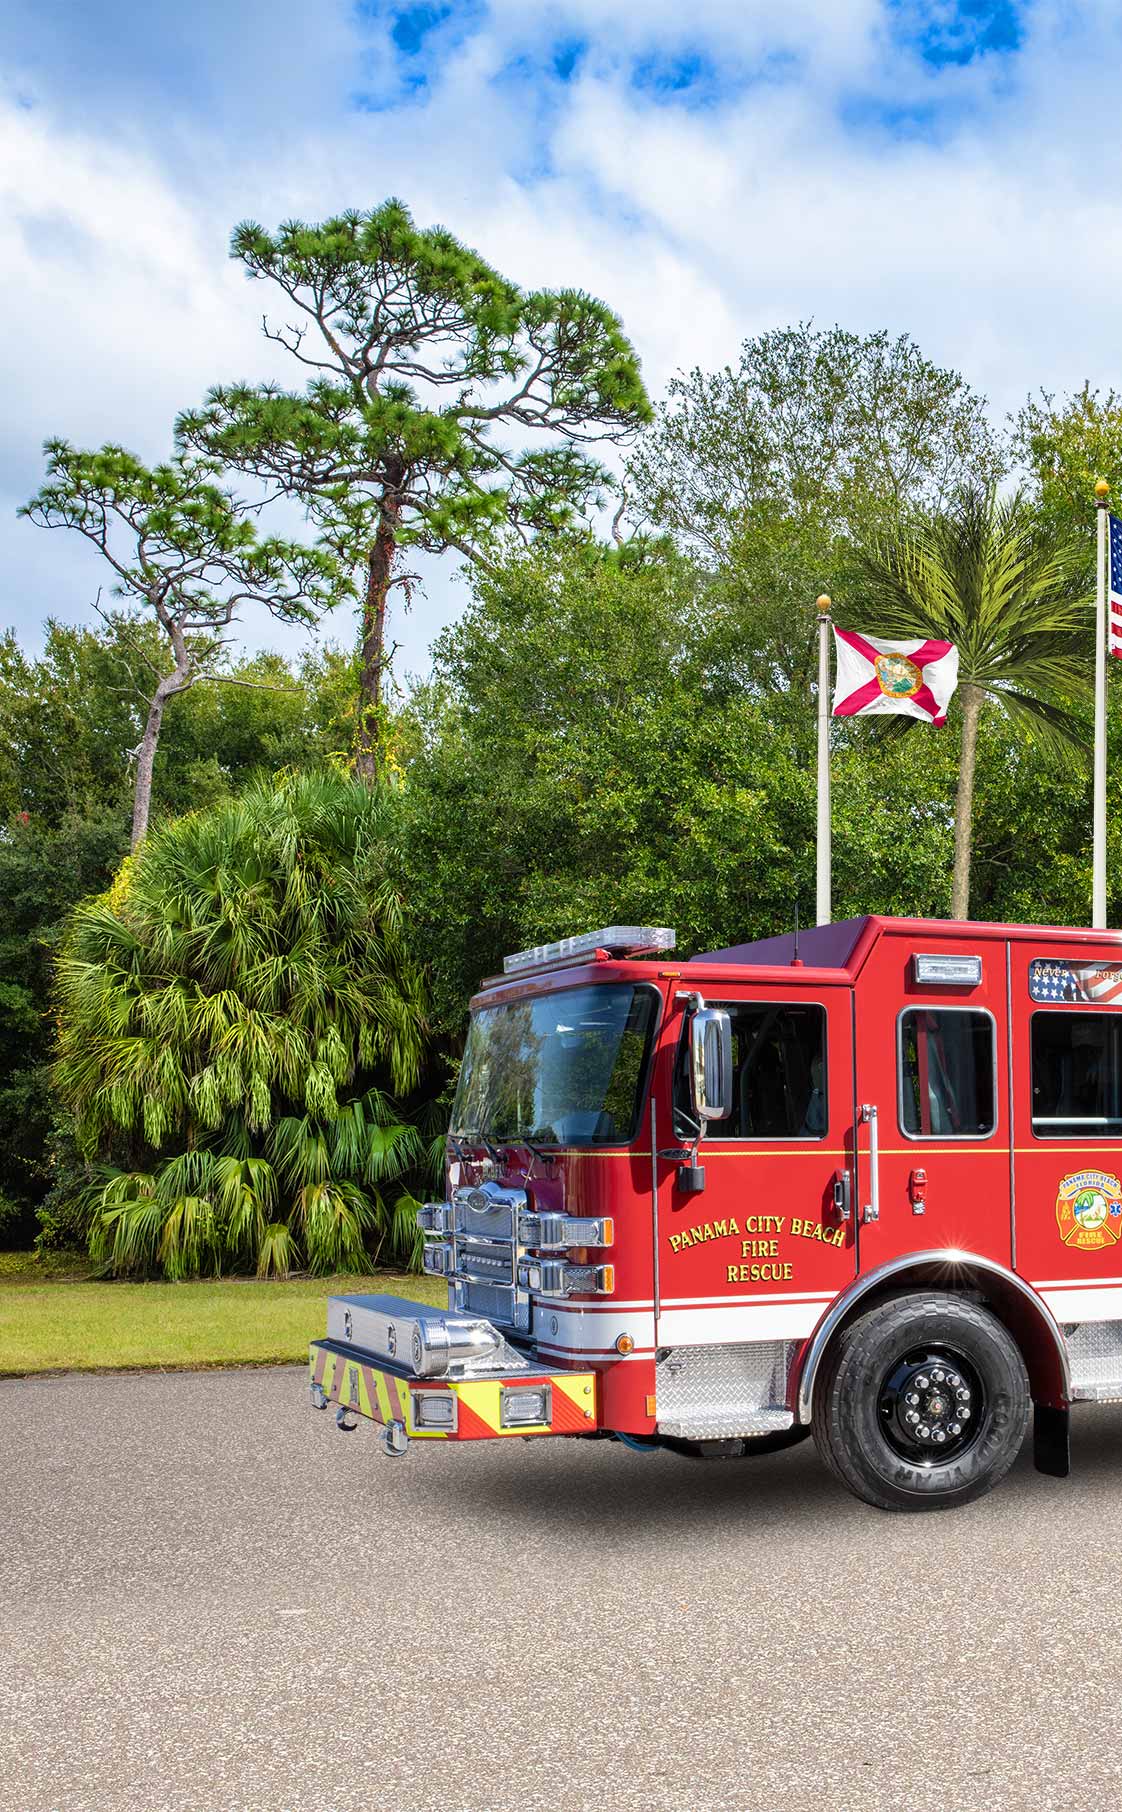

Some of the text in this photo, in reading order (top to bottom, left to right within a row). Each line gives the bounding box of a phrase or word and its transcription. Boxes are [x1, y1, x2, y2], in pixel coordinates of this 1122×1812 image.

[1034, 967, 1067, 977] Never
[668, 1215, 847, 1254] PANAMA CITY BEACH
[741, 1240, 779, 1259] FIRE
[727, 1263, 793, 1283] RESCUE
